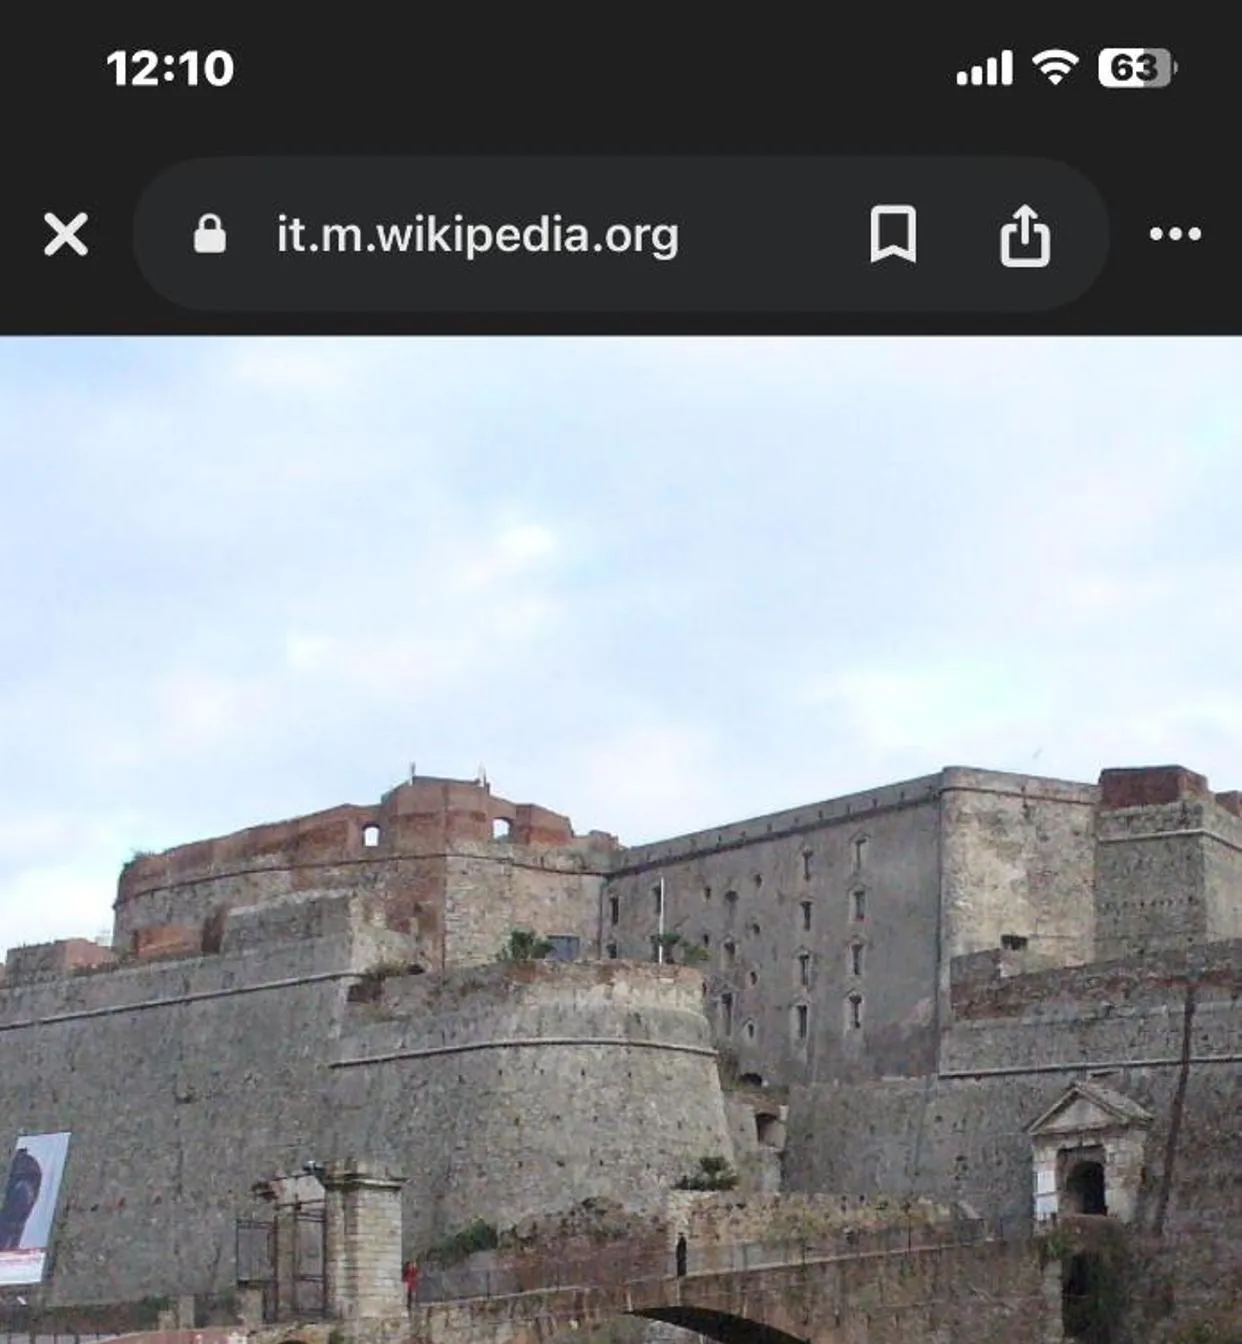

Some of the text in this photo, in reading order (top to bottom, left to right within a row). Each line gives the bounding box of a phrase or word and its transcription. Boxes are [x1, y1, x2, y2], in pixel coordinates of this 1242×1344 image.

[106, 49, 234, 87] 12:10
[1110, 53, 1159, 82] 63
[278, 213, 679, 261] it.m.wikipedia.org
